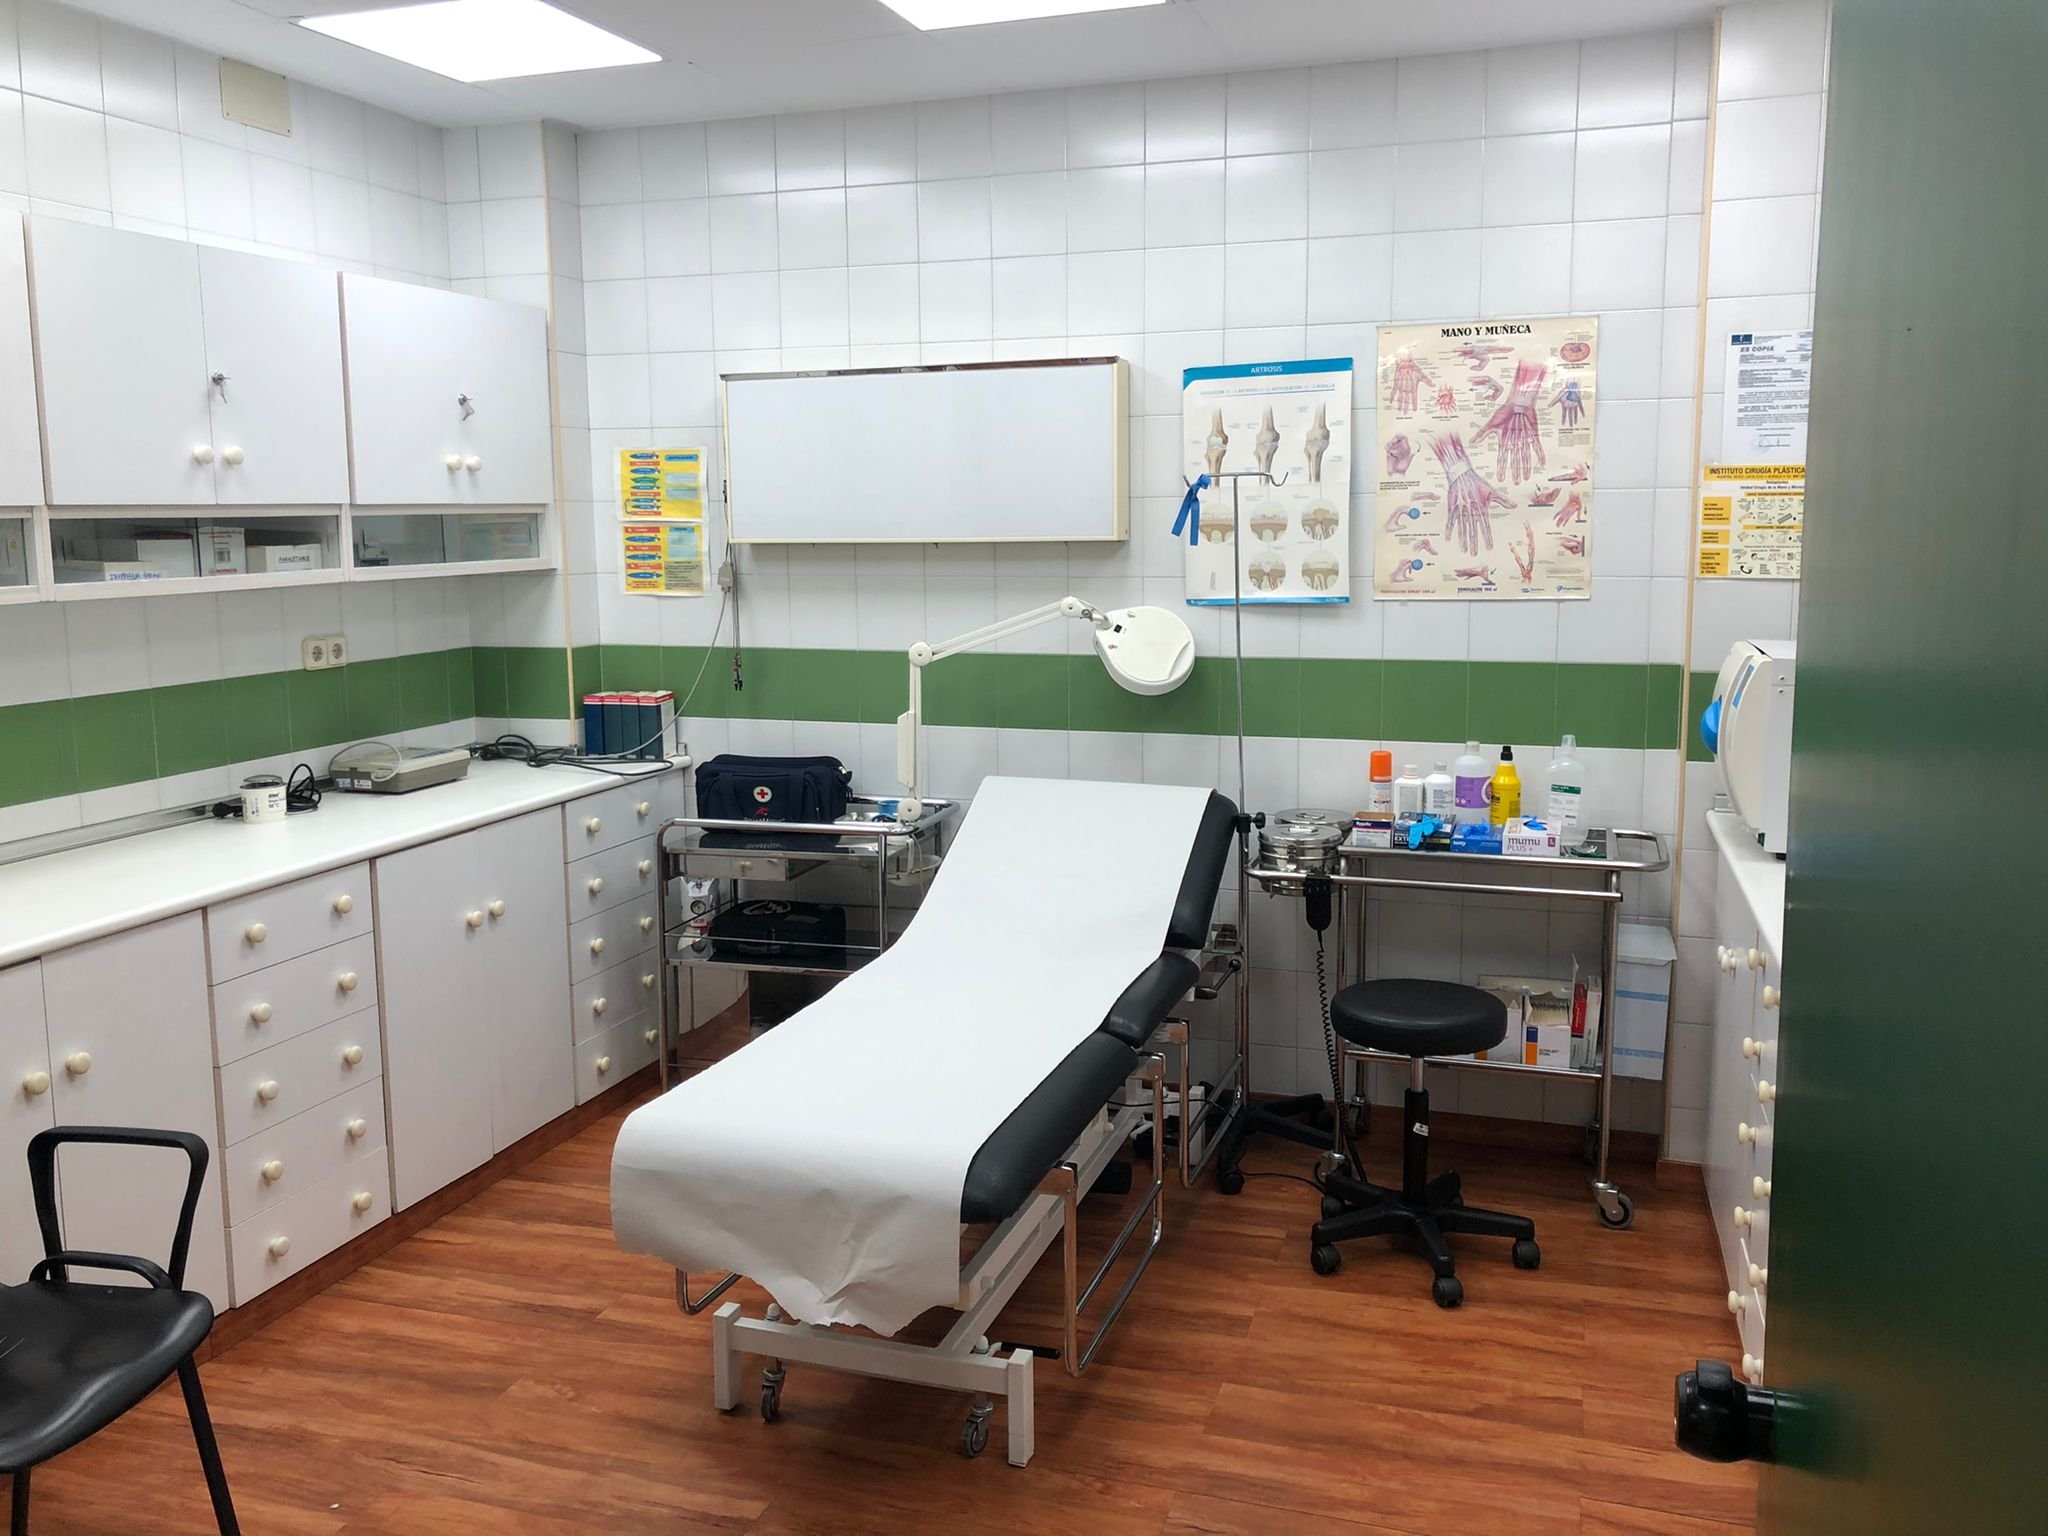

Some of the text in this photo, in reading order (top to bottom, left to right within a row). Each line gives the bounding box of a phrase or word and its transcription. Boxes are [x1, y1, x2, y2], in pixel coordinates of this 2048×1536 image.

[1441, 324, 1531, 338] MANO Y MUÑECA
[1250, 365, 1283, 374] ARTROSIS
[1709, 465, 1805, 475] INSTITUTO CIRUGÍA PLÁSTICA
[1508, 837, 1540, 846] mumu
